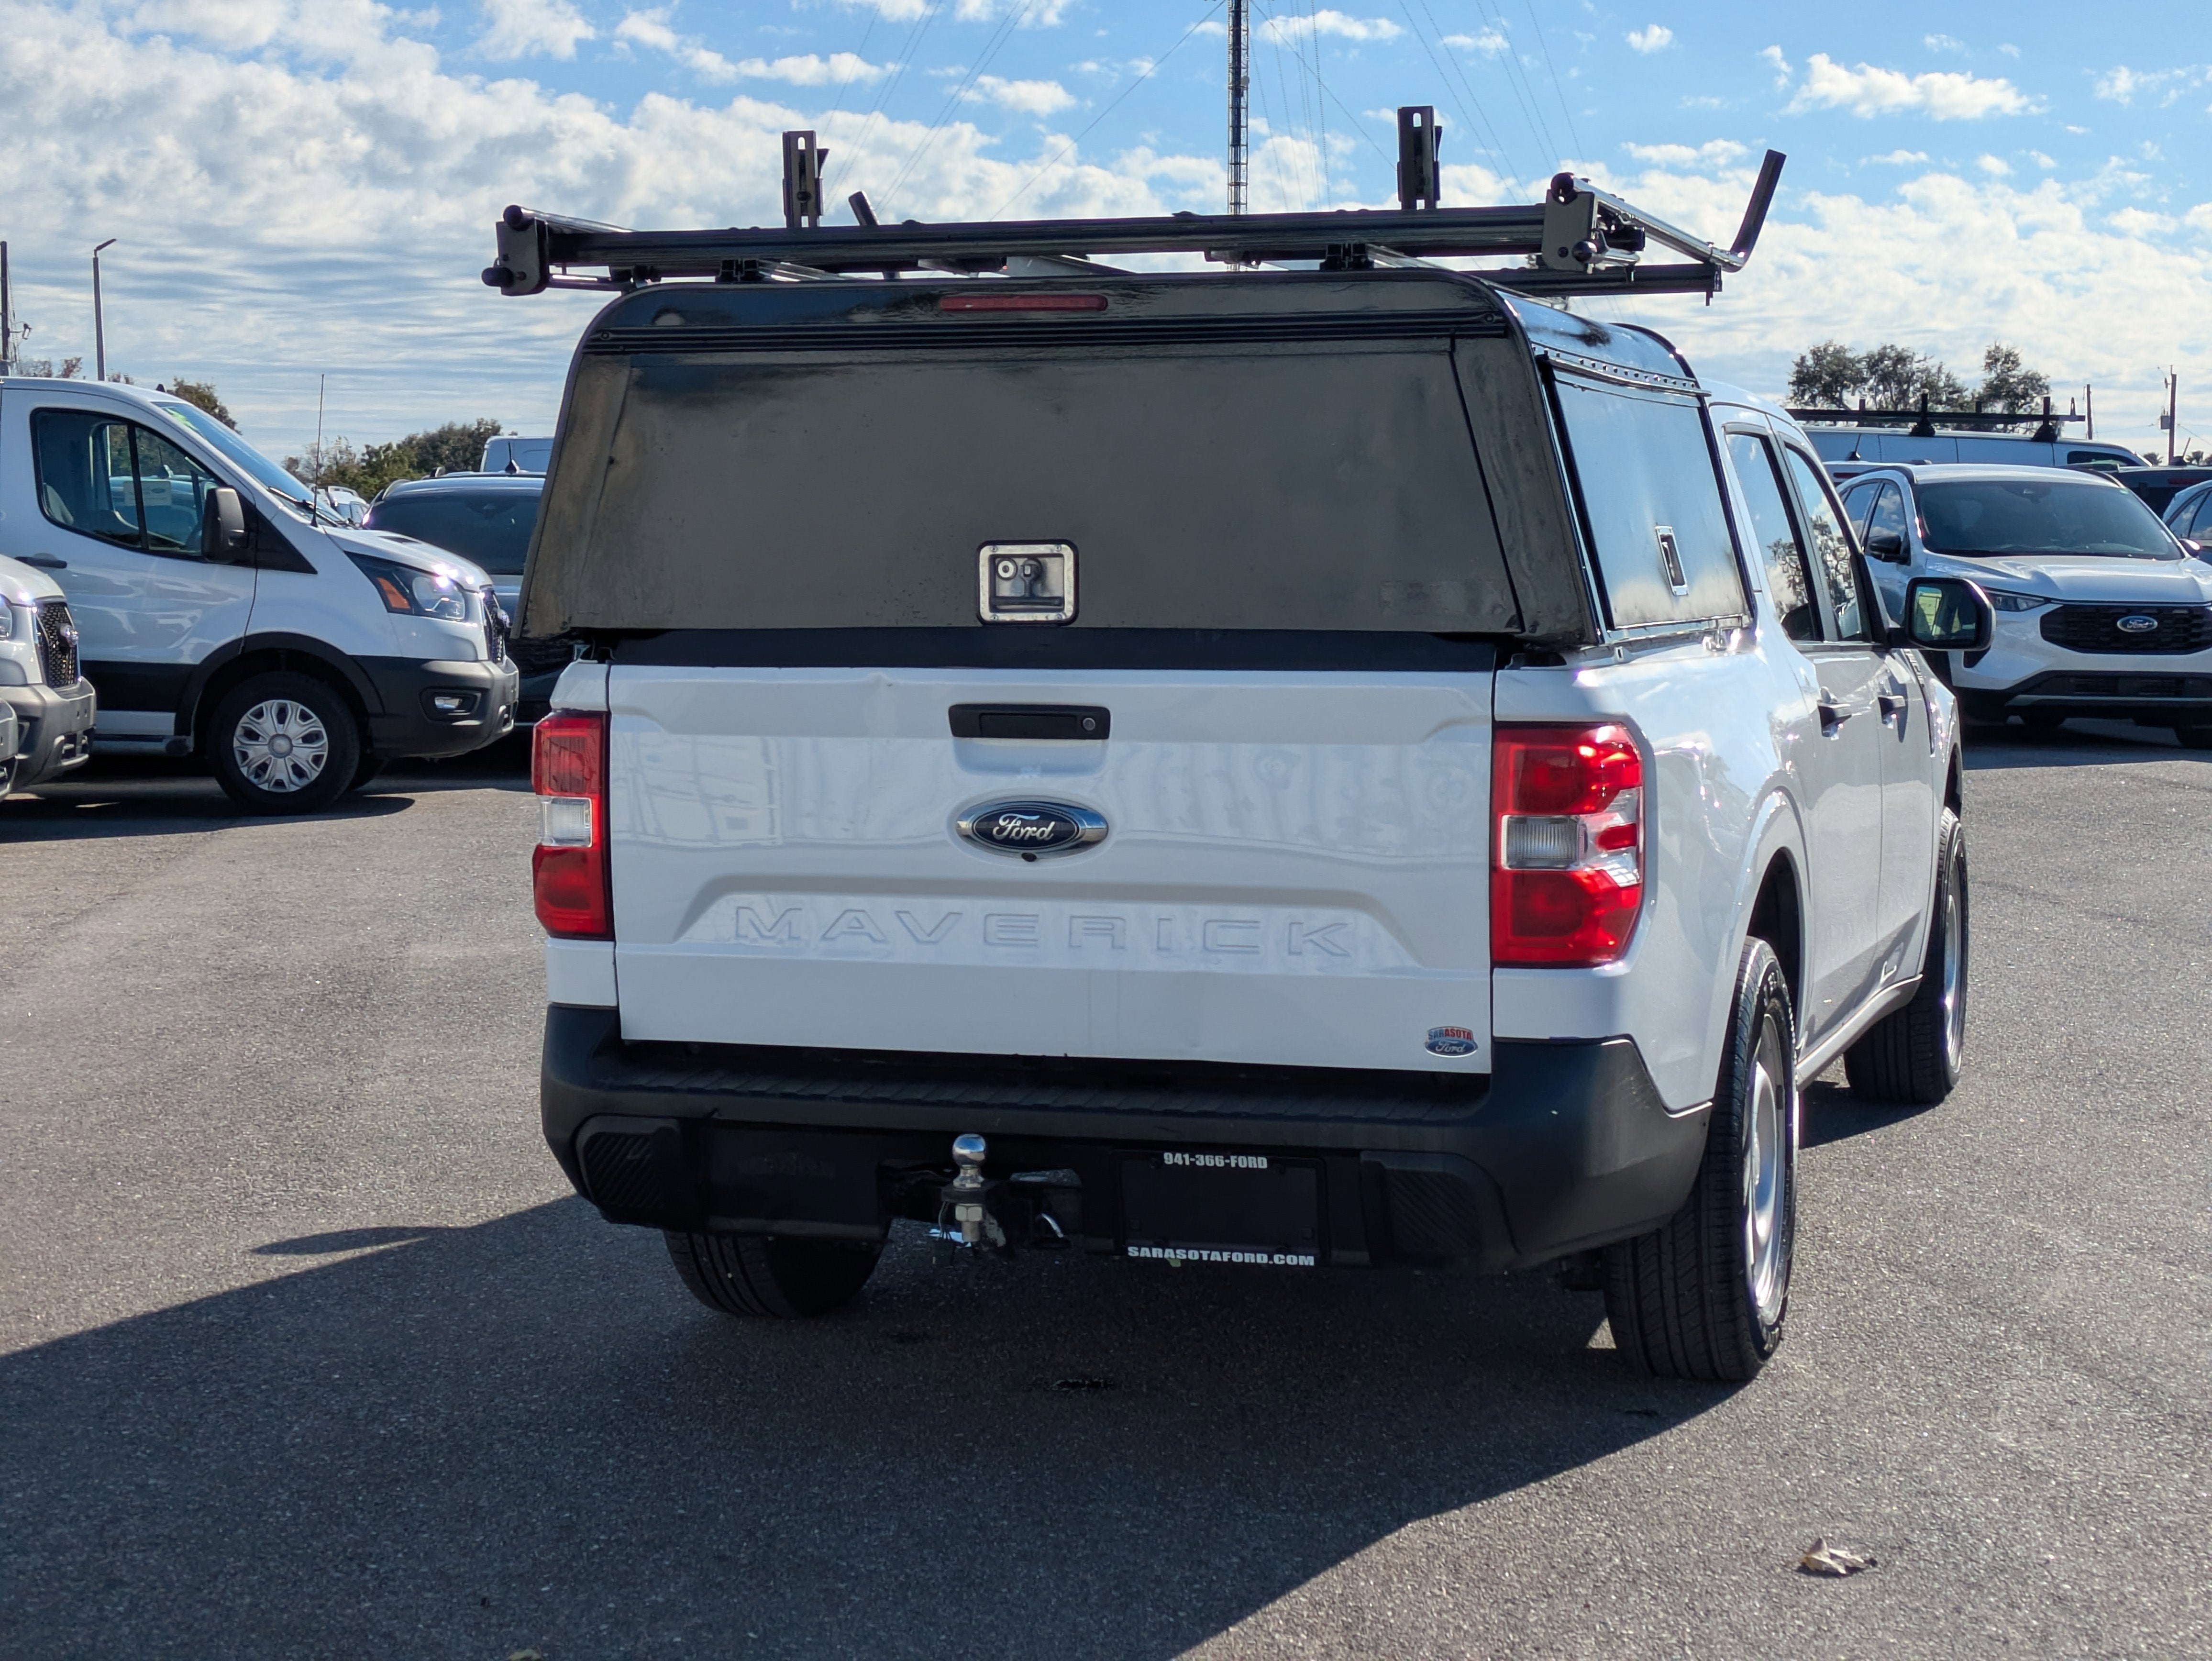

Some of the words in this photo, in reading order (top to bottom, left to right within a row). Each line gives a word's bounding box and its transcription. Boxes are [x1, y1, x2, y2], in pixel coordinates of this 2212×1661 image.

[2127, 619, 2153, 628] Ford
[992, 813, 1056, 841] Ford
[734, 905, 1352, 957] MAVERICK
[1428, 1028, 1472, 1041] SARASOTA
[1436, 1040, 1466, 1052] Ford
[1163, 1152, 1268, 1169] 941-366-FORD
[1128, 1246, 1315, 1266] SARASOTAFORD.COM
